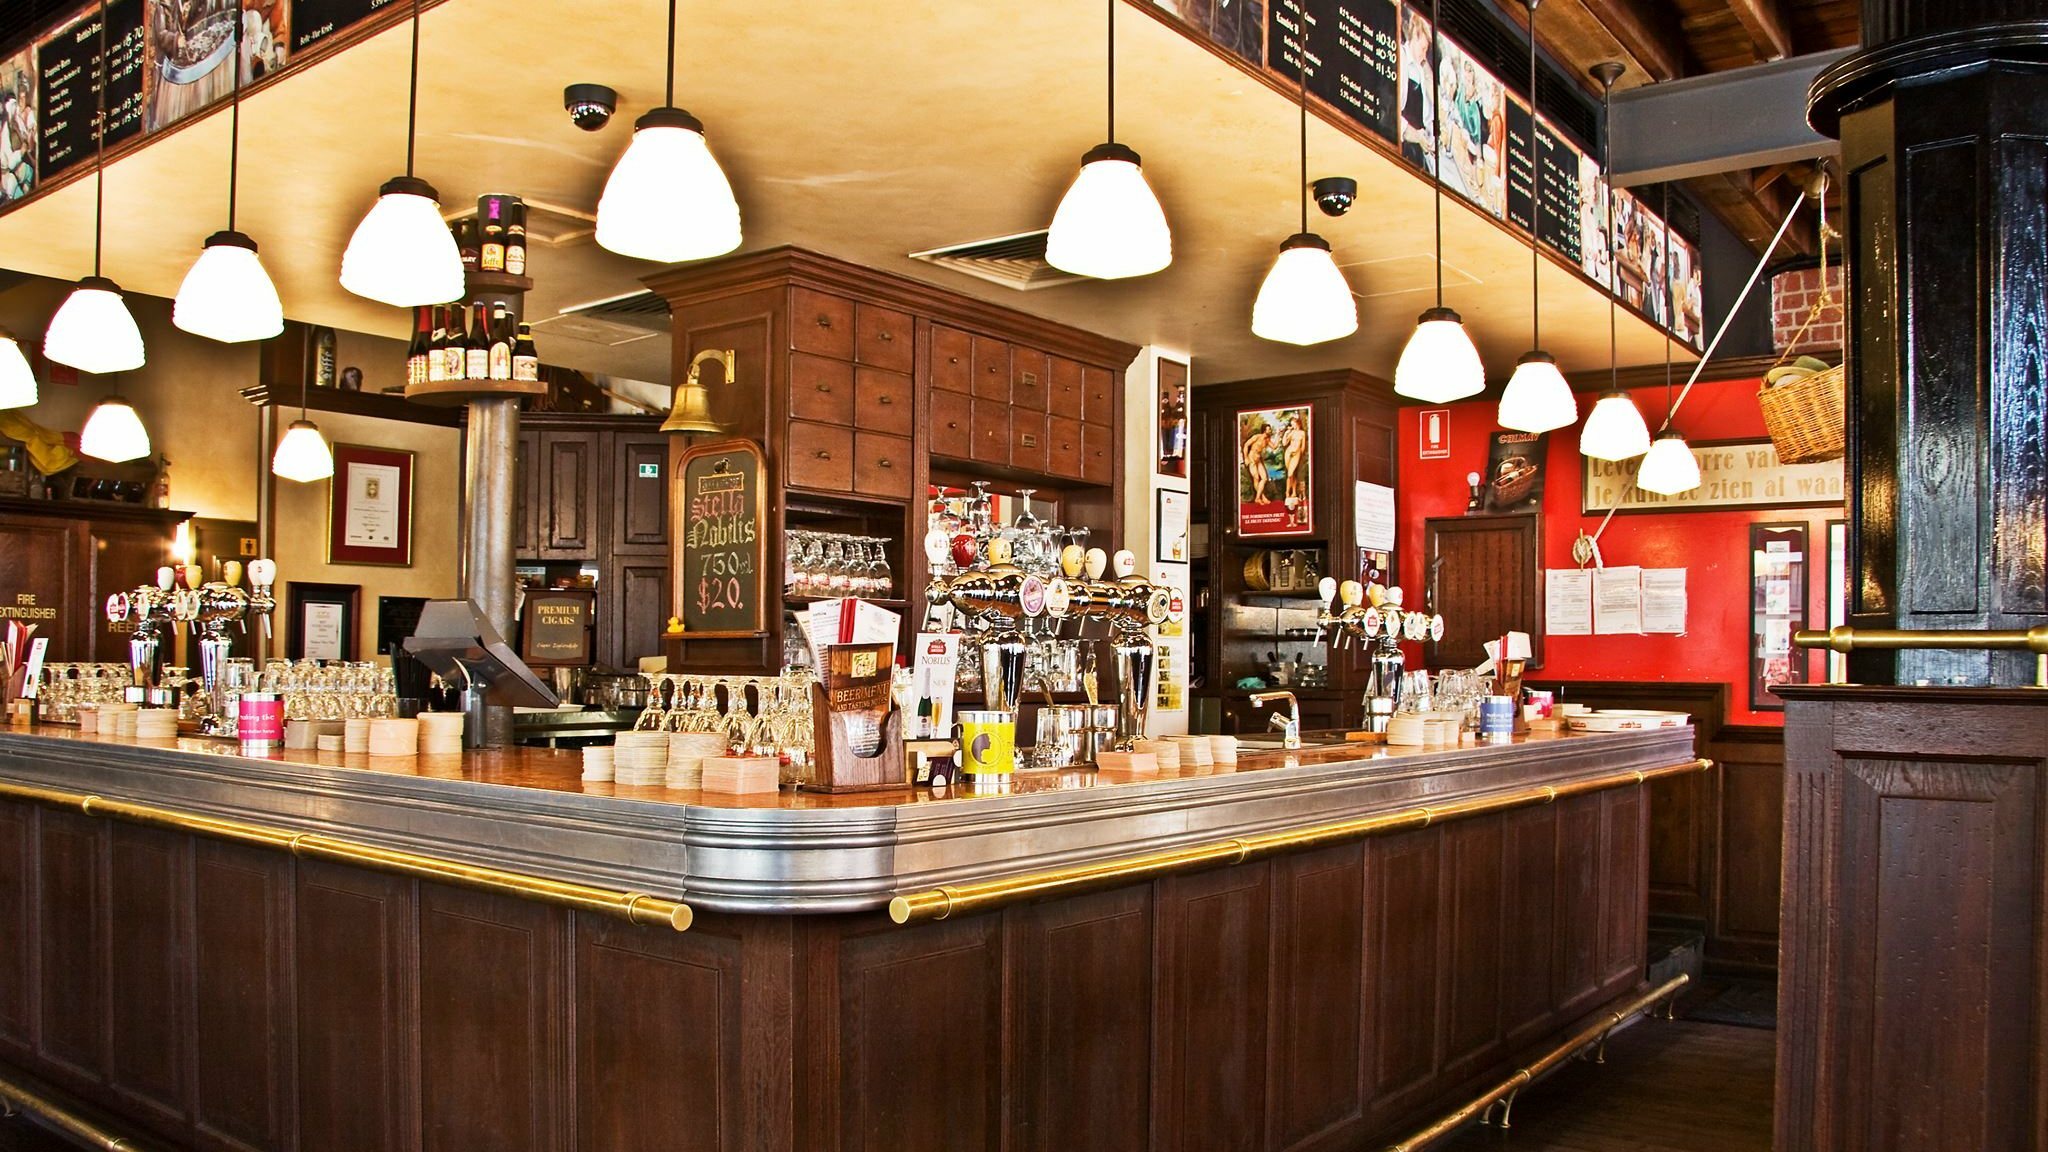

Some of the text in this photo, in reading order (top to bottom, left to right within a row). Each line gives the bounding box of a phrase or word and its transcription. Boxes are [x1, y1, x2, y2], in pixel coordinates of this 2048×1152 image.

[1710, 479, 1753, 500] zien
[1764, 475, 1785, 497] al
[17, 593, 36, 605] FIRE
[537, 605, 580, 615] PREMIUM
[542, 615, 575, 625] CIGARS
[921, 655, 951, 666] NOBILIS
[836, 681, 890, 703] BEER MENU
[836, 703, 848, 712] AND
[848, 699, 870, 711] TASTING
